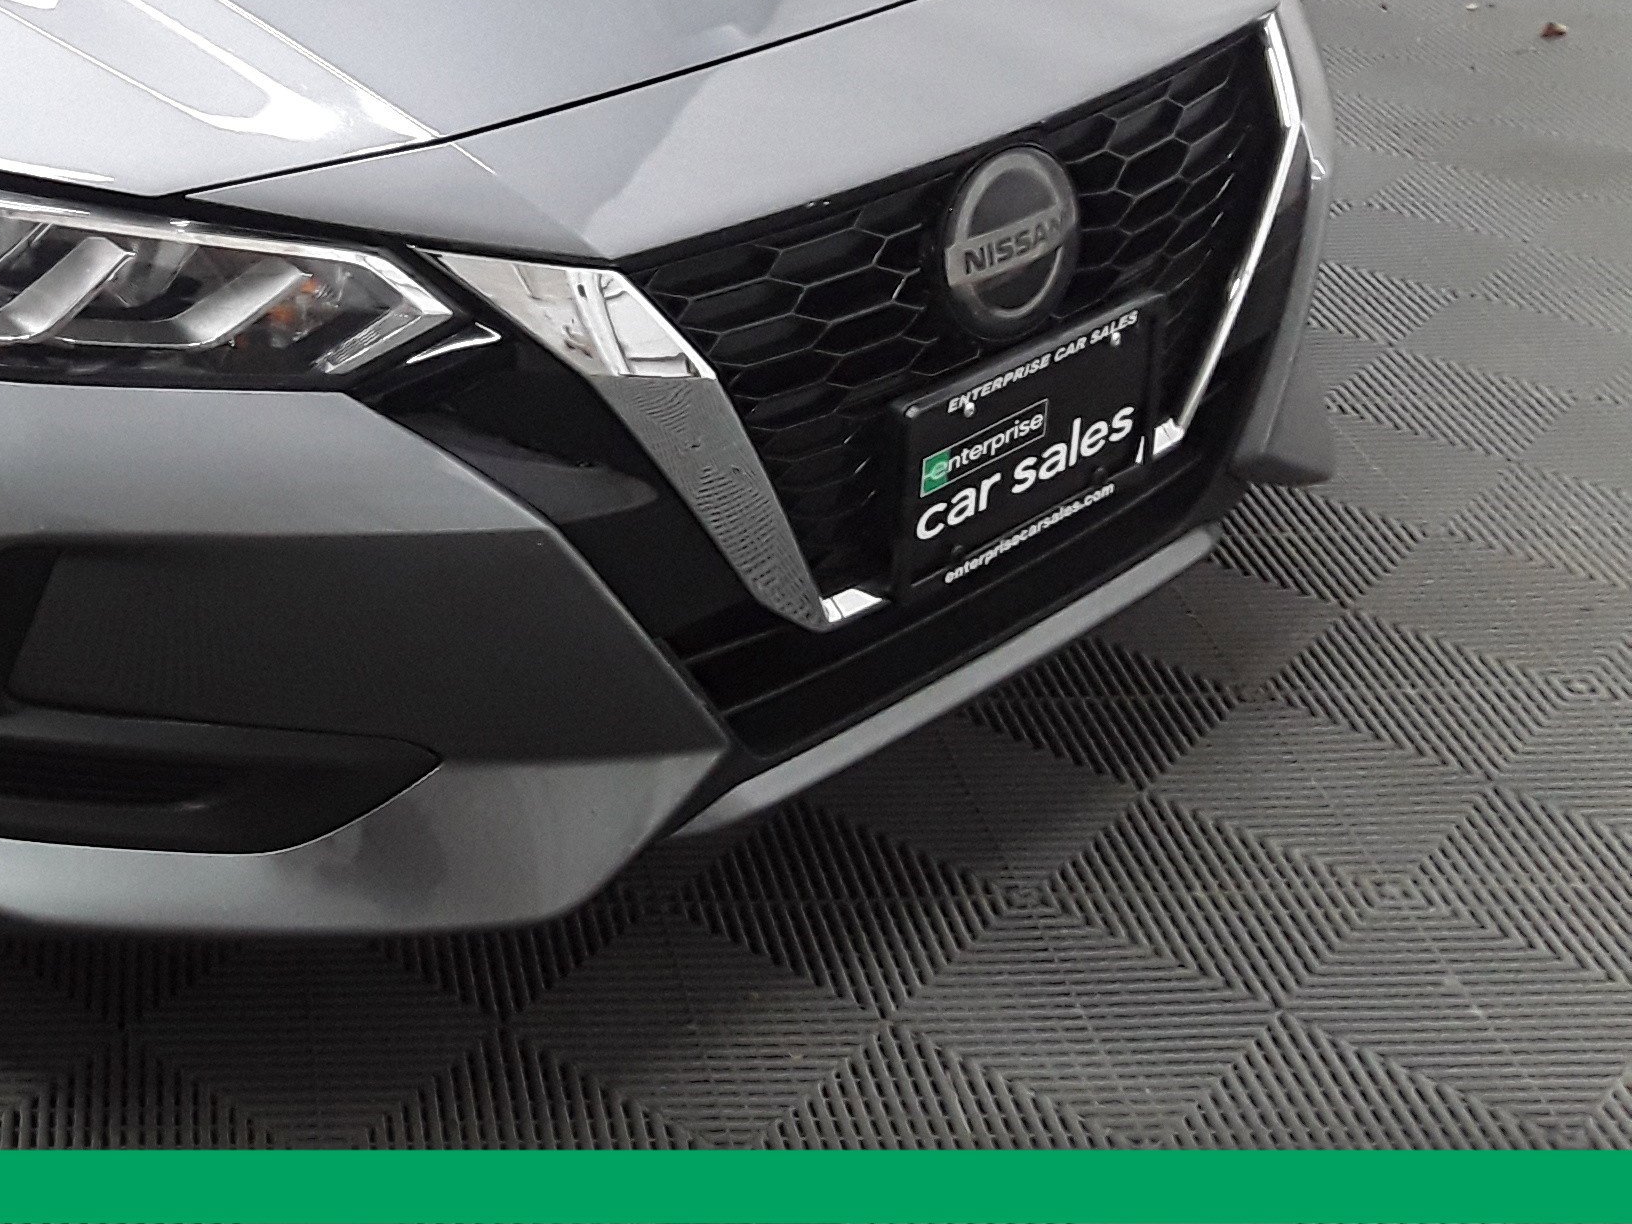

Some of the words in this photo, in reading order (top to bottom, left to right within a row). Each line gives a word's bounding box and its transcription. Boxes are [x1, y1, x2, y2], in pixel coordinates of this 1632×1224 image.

[964, 213, 1062, 275] NISSAN
[947, 353, 1052, 413] ENTERPRISE
[1054, 336, 1088, 363] CAR
[1089, 309, 1139, 345] SALES
[916, 472, 1002, 541] car
[1011, 405, 1135, 494] sales
[929, 412, 1045, 481] enterprise
[944, 482, 1116, 584] enterprisecarsales.com
